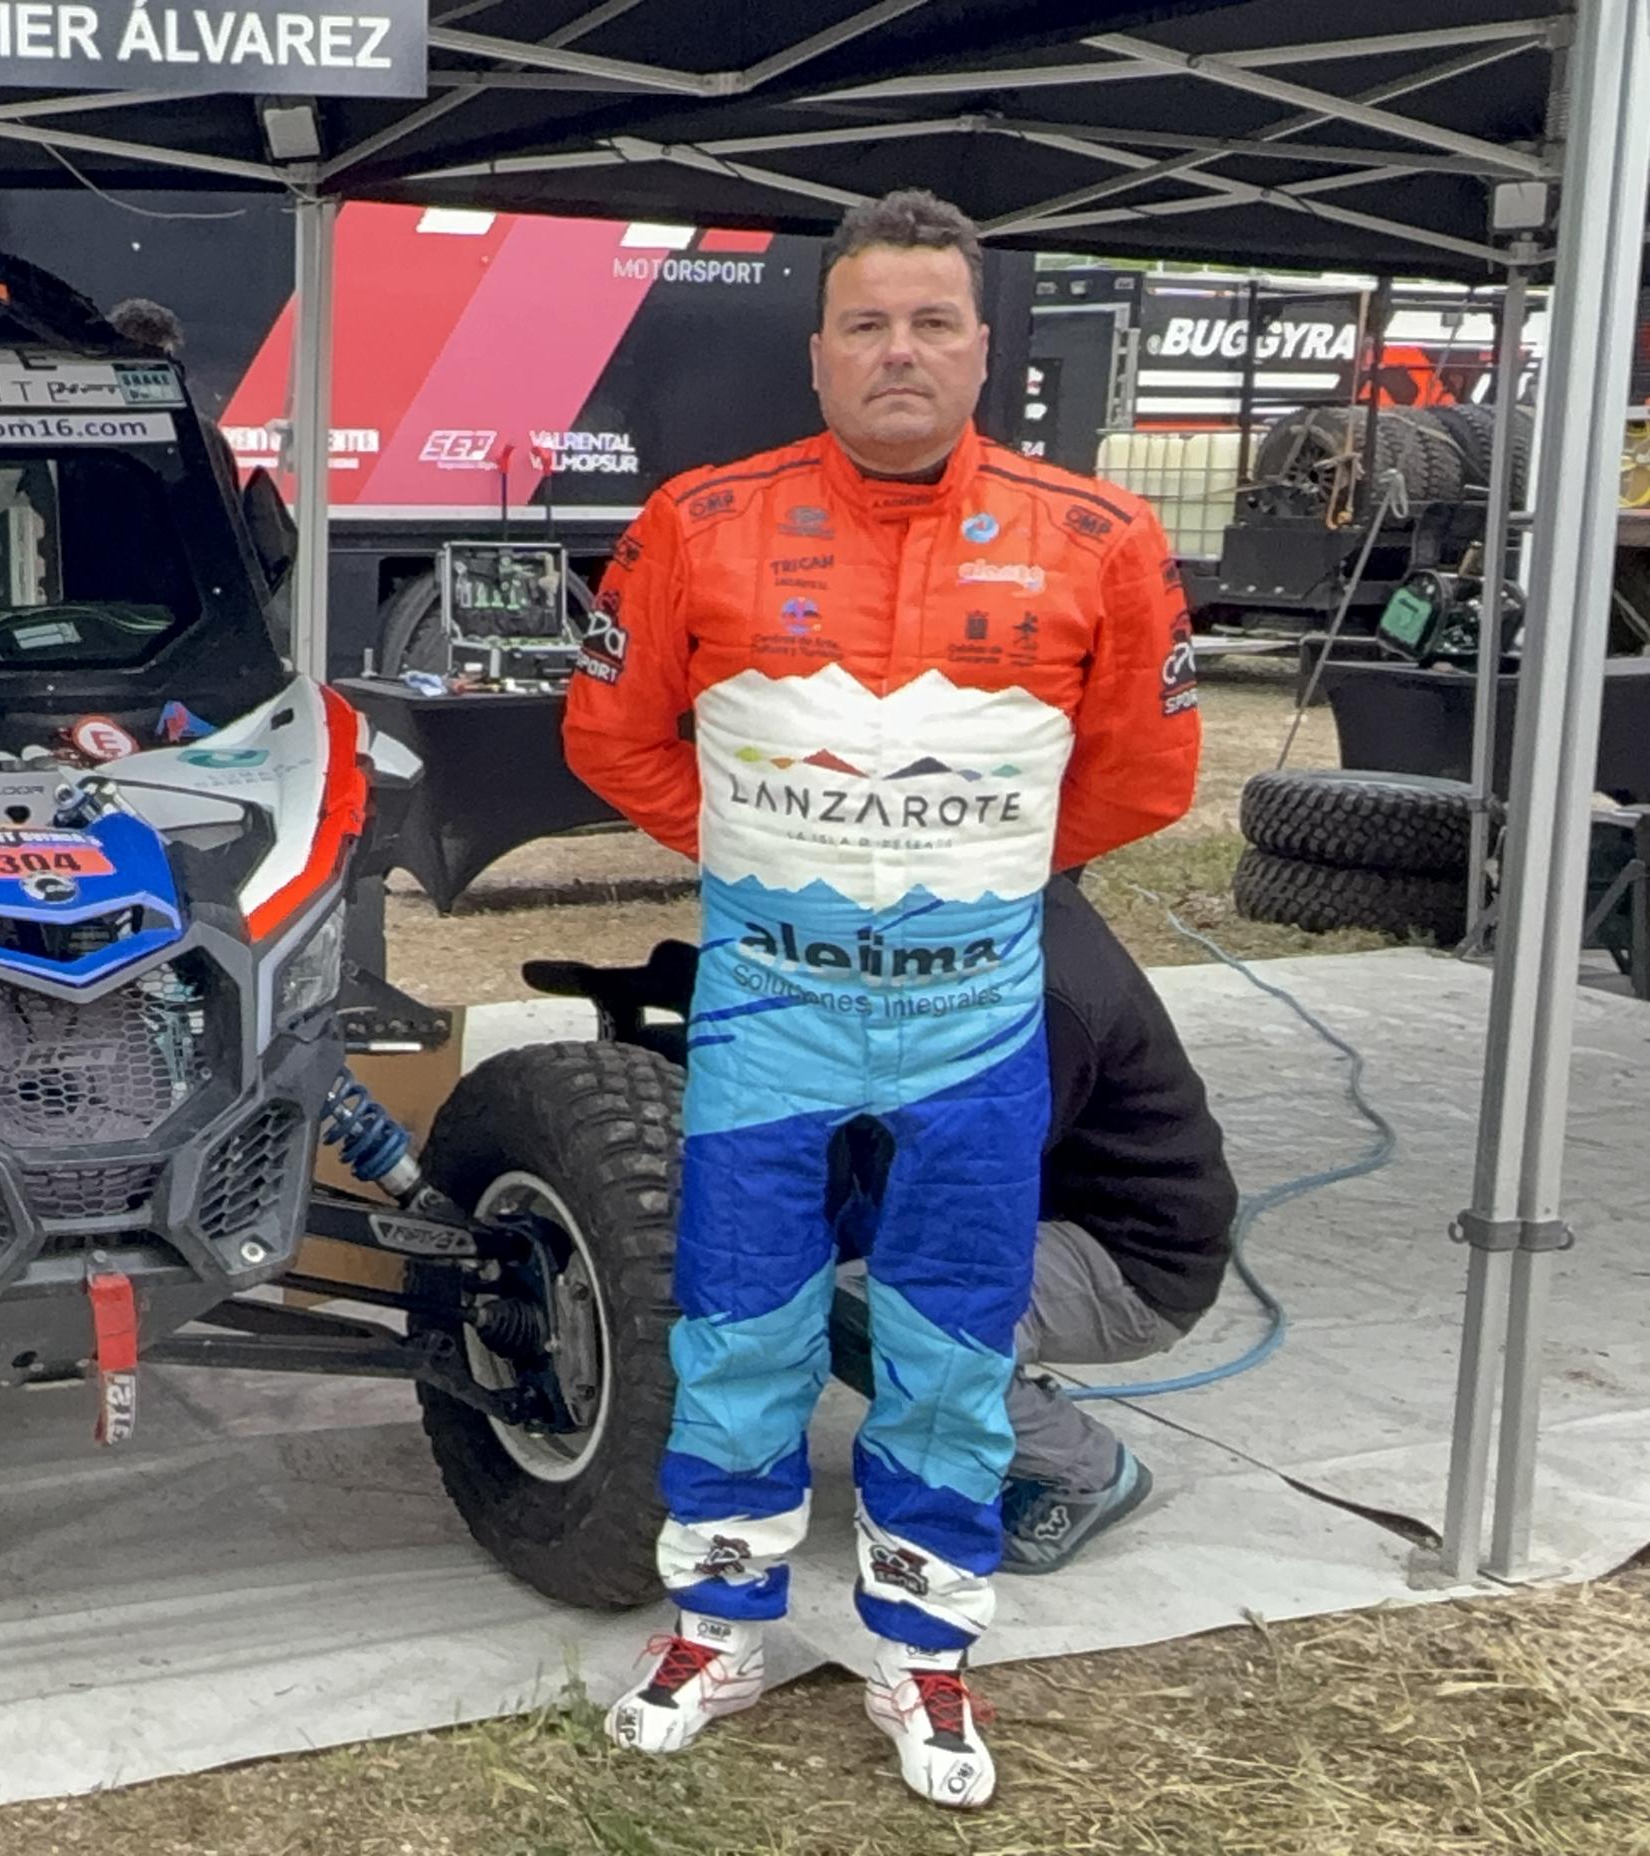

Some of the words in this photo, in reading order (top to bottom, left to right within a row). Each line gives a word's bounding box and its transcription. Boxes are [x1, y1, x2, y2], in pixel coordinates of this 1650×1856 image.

[117, 0, 392, 68] ÁLVAREZ
[613, 257, 765, 284] MOTORSPORT
[1159, 317, 1358, 361] BUGGYRA
[1065, 504, 1113, 536] OMP
[90, 730, 121, 757] E
[729, 773, 1022, 828] LANZAROTE
[884, 985, 1002, 1018] Integrales
[697, 1621, 731, 1637] OMP
